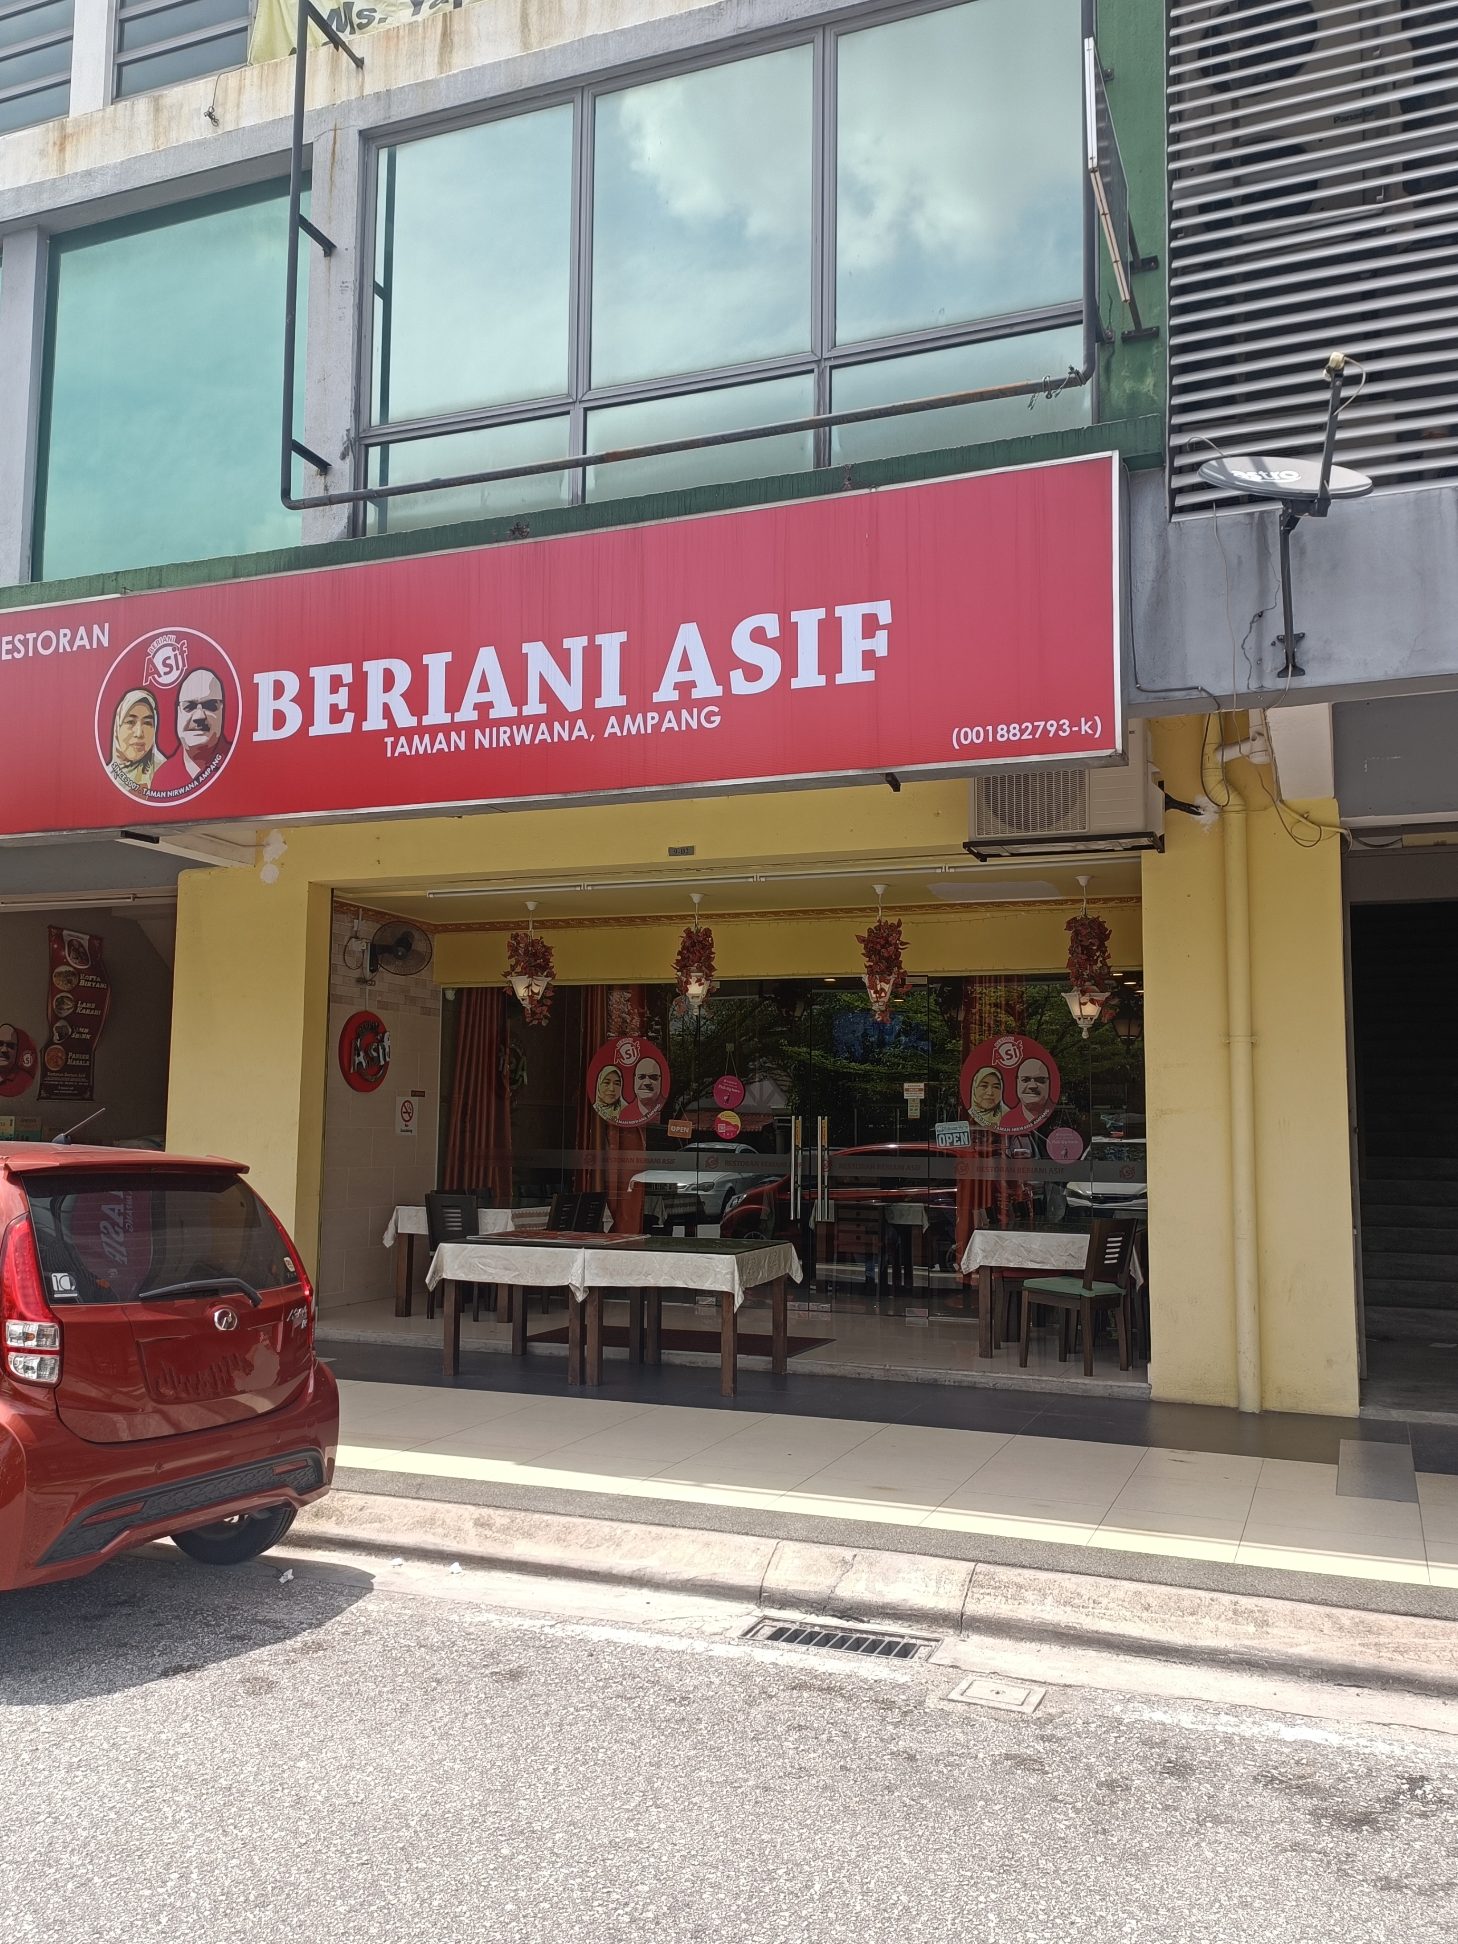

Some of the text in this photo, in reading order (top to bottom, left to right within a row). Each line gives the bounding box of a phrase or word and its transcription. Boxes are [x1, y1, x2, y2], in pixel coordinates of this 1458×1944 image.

[326, 2, 388, 35] Ms.
[1, 623, 109, 660] ESTORAN
[149, 635, 177, 657] BERIANI
[252, 600, 892, 742] BERIANI ASIF
[385, 705, 722, 758] TAMAN NIRWANA, AMPANG
[951, 715, 1102, 750] (001882793-k)
[142, 786, 167, 799] TAMAN
[167, 780, 199, 798] NIRWANA
[198, 753, 223, 783] AMPANG
[671, 1126, 689, 1134] OPEN
[939, 1132, 969, 1147] OPEN
